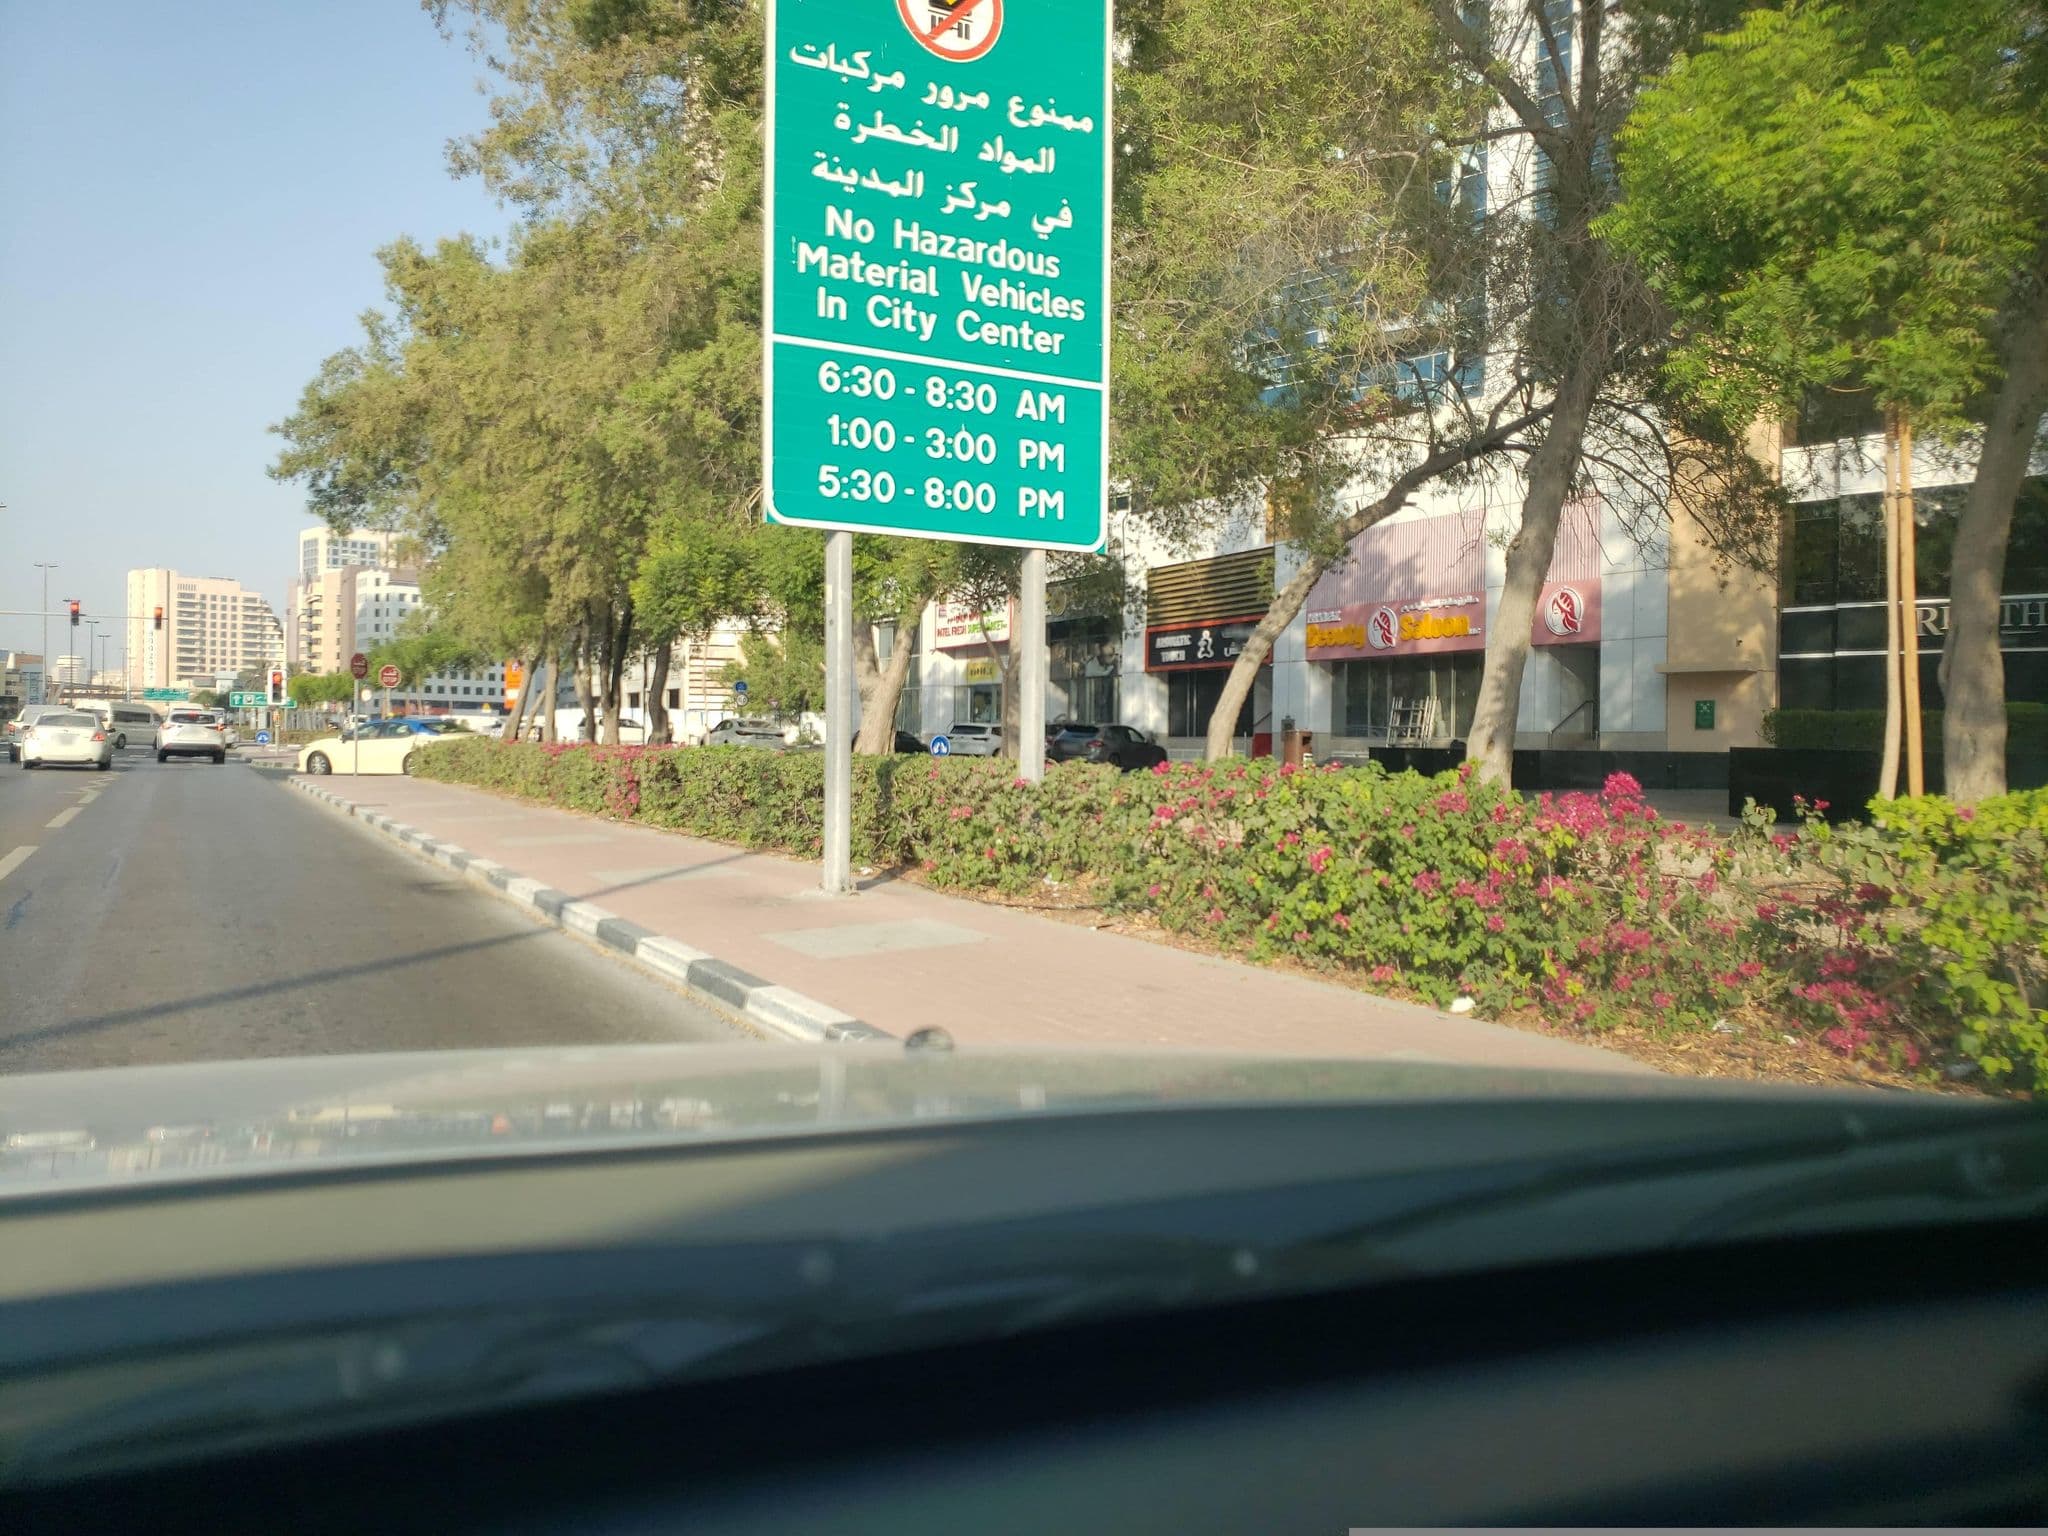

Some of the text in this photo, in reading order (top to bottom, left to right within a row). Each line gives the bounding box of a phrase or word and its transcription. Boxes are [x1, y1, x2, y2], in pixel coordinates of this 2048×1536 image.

[789, 43, 1094, 133] ممنوع مرور مركبات
[834, 102, 1055, 174] المواد الخطرة
[811, 151, 1073, 240] في مركز المدينة
[825, 205, 1061, 279] No Hazardous
[797, 242, 1086, 321] Material Vehicles
[817, 286, 1066, 355] In City Center
[817, 360, 896, 400] 6:30
[925, 375, 998, 415] 8:30
[1015, 389, 1066, 424] AM
[827, 413, 896, 452] 1:00
[925, 427, 997, 465] 3:00
[1018, 438, 1065, 473] PM
[817, 464, 896, 504] 5:30
[923, 476, 997, 514] 8:00
[1017, 486, 1065, 521] PM
